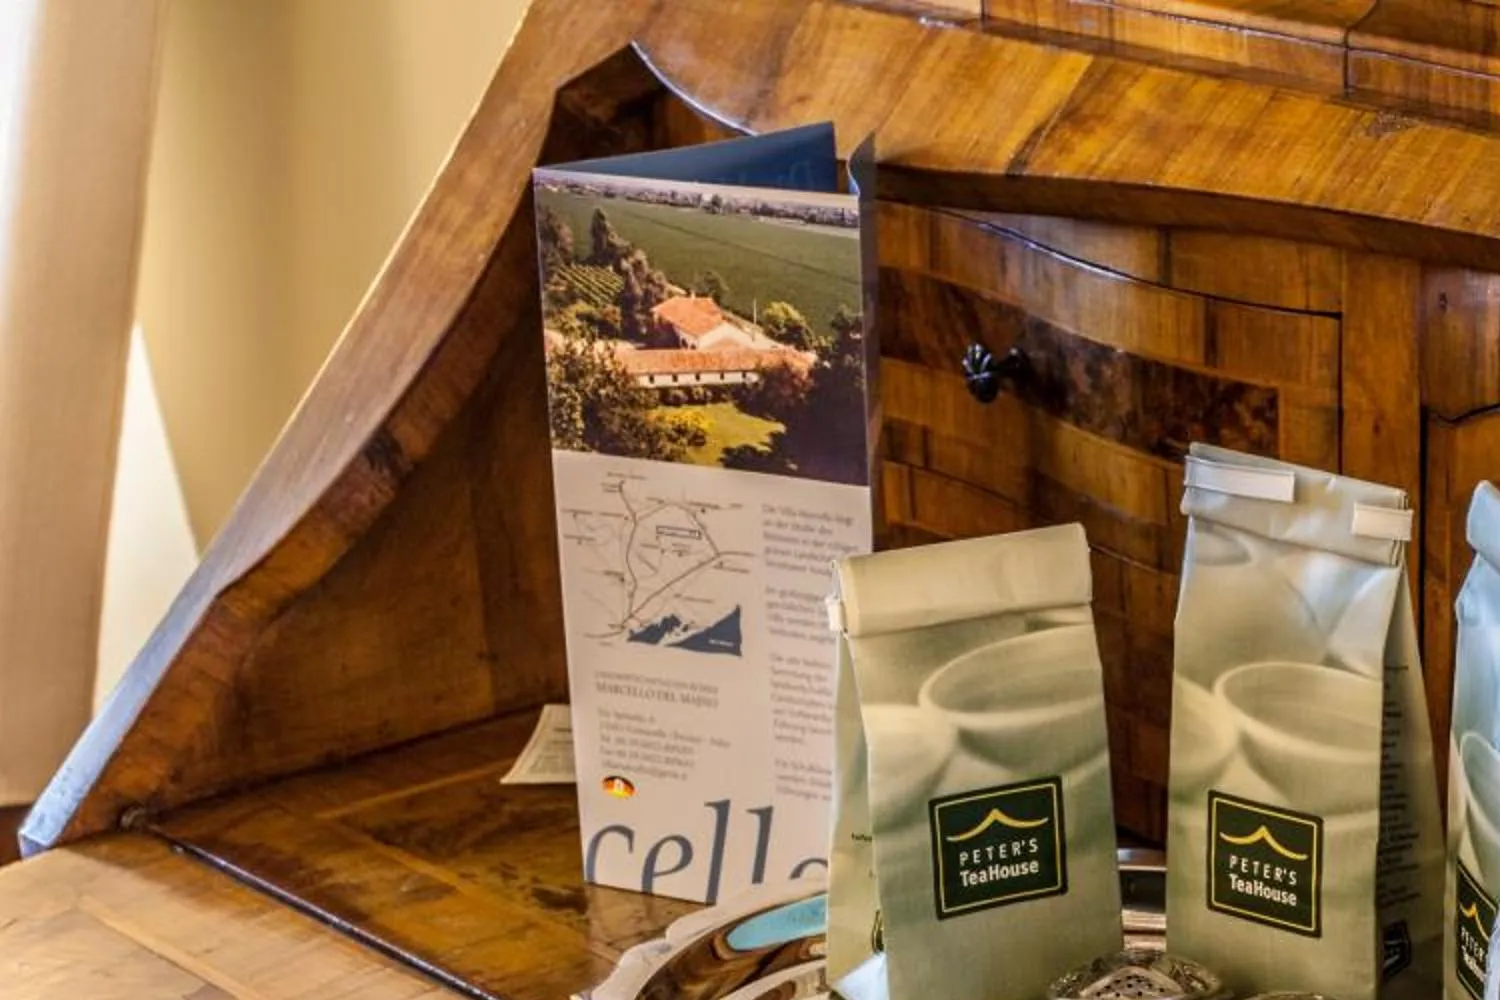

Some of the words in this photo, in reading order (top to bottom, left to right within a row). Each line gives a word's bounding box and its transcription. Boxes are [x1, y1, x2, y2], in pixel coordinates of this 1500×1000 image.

[959, 837, 1039, 866] PETER'S
[959, 860, 1039, 888] TeaHouse
[1229, 854, 1297, 886] PETER'S
[1229, 873, 1297, 907] TeaHouse
